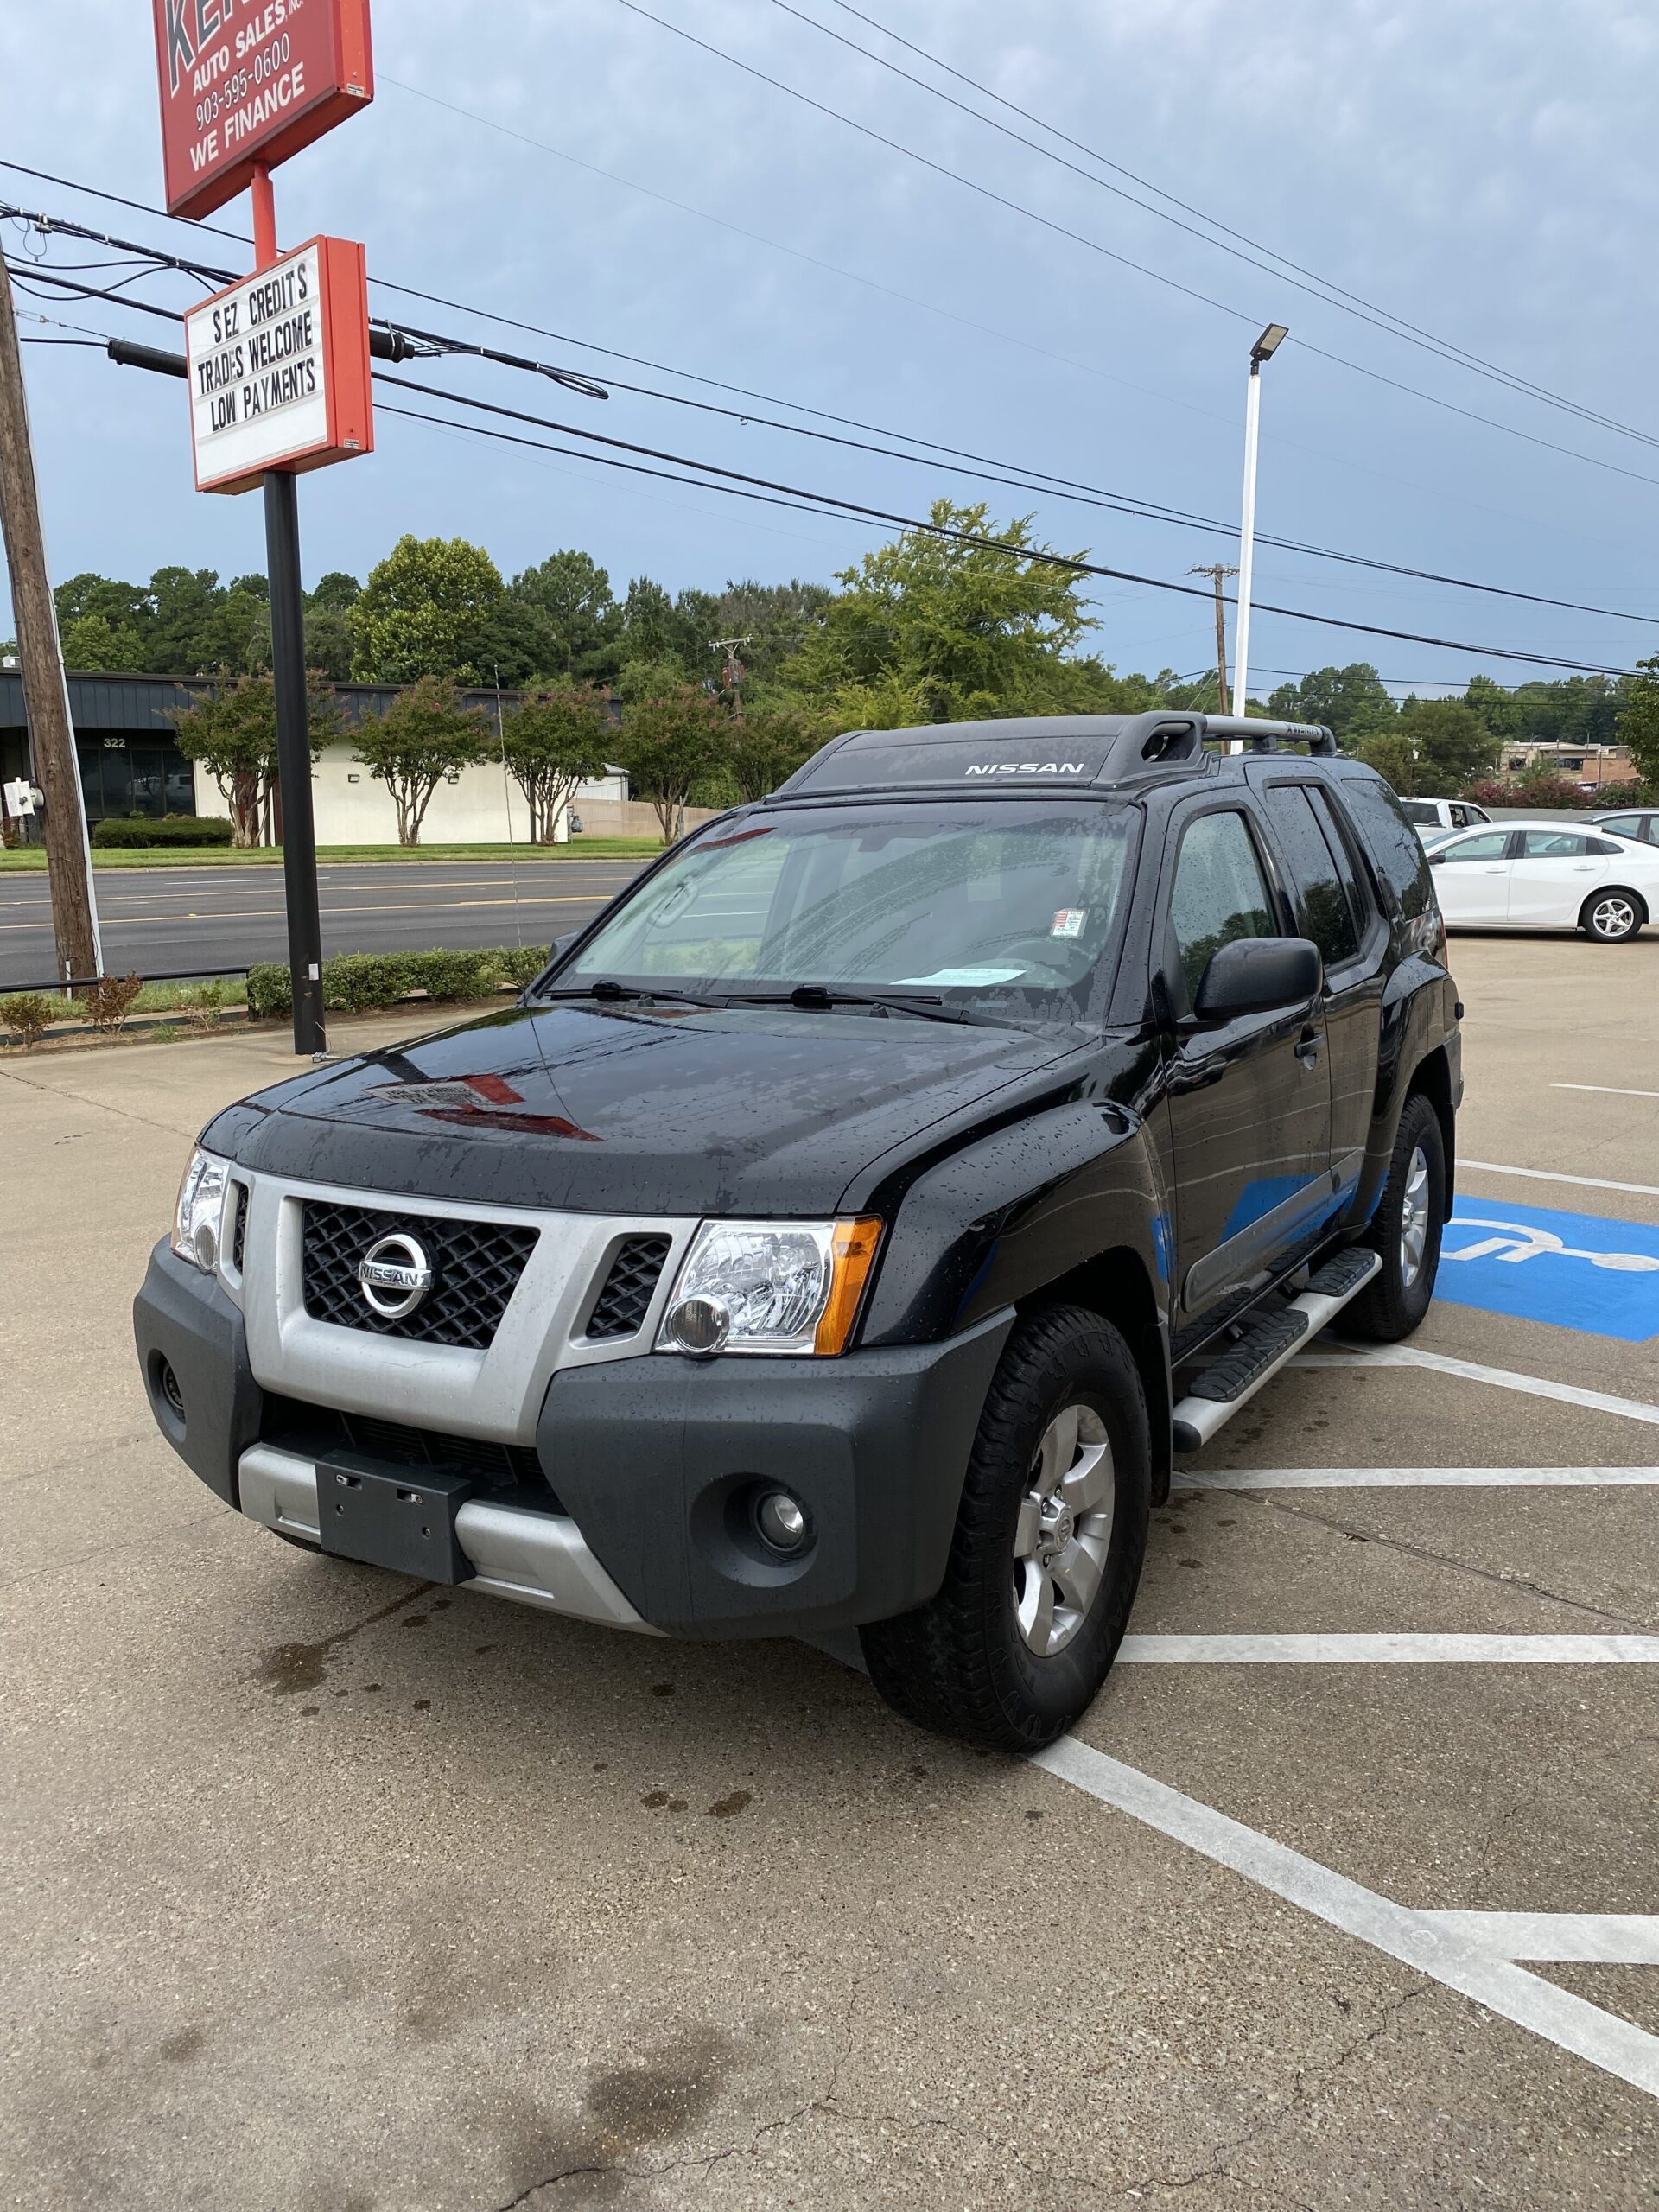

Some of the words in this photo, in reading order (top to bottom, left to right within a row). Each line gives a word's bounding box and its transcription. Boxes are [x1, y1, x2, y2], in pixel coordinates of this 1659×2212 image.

[193, 45, 230, 97] AUTO
[196, 32, 290, 130] 903-595-0600
[189, 129, 219, 171] WE
[224, 61, 305, 149] FINANCE
[249, 263, 307, 326] CREDITS
[198, 345, 244, 394] TRADES
[248, 310, 312, 372] WELCOME
[211, 391, 236, 432] LOW
[244, 357, 315, 419] PAYMENTS
[104, 738, 125, 748] 322
[965, 763, 1085, 775] NISSAN
[360, 1262, 418, 1286] NISSAN
